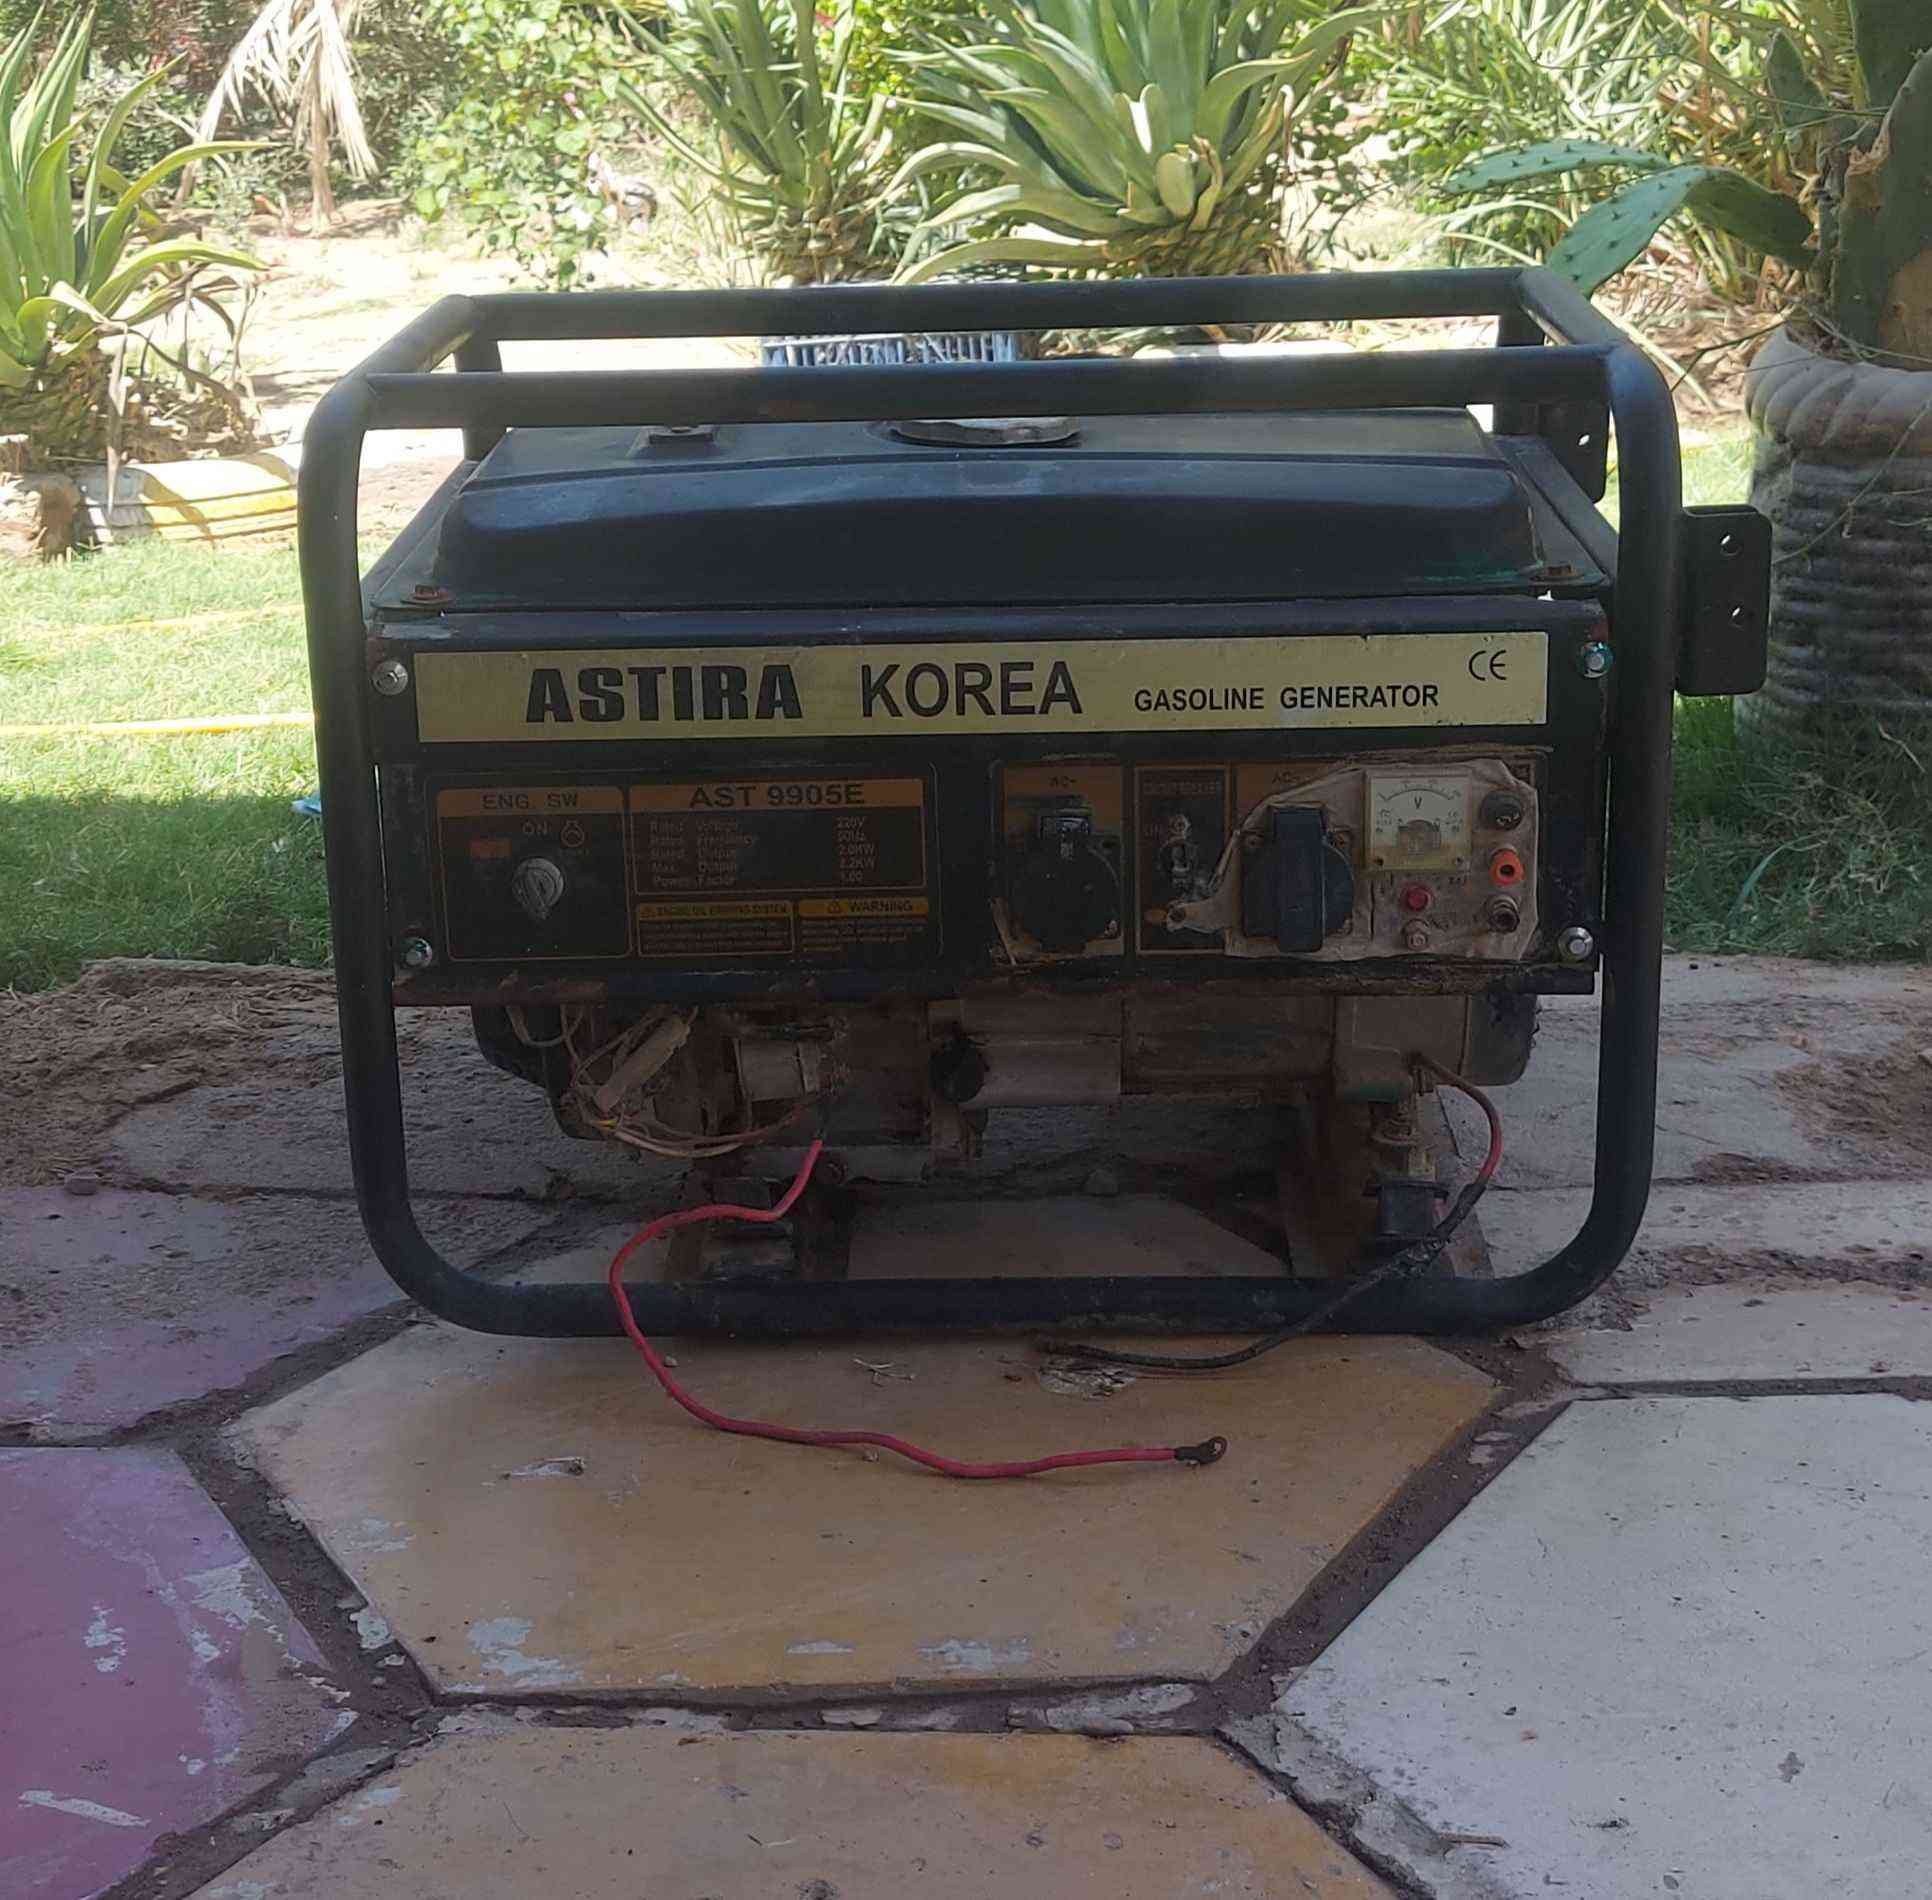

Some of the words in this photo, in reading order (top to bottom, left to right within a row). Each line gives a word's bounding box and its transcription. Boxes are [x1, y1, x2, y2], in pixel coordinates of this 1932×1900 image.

[1468, 650, 1507, 681] CE
[526, 664, 803, 723] ASTIRA
[861, 660, 1083, 718] KOREA
[1134, 687, 1265, 712] GASOLINE
[1280, 684, 1440, 709] GENERATOR
[546, 791, 578, 808] SW
[689, 785, 757, 809] AST
[767, 783, 866, 807] 9905E
[1413, 796, 1423, 810] V
[522, 821, 549, 836] ON
[849, 900, 914, 914] WARNING
